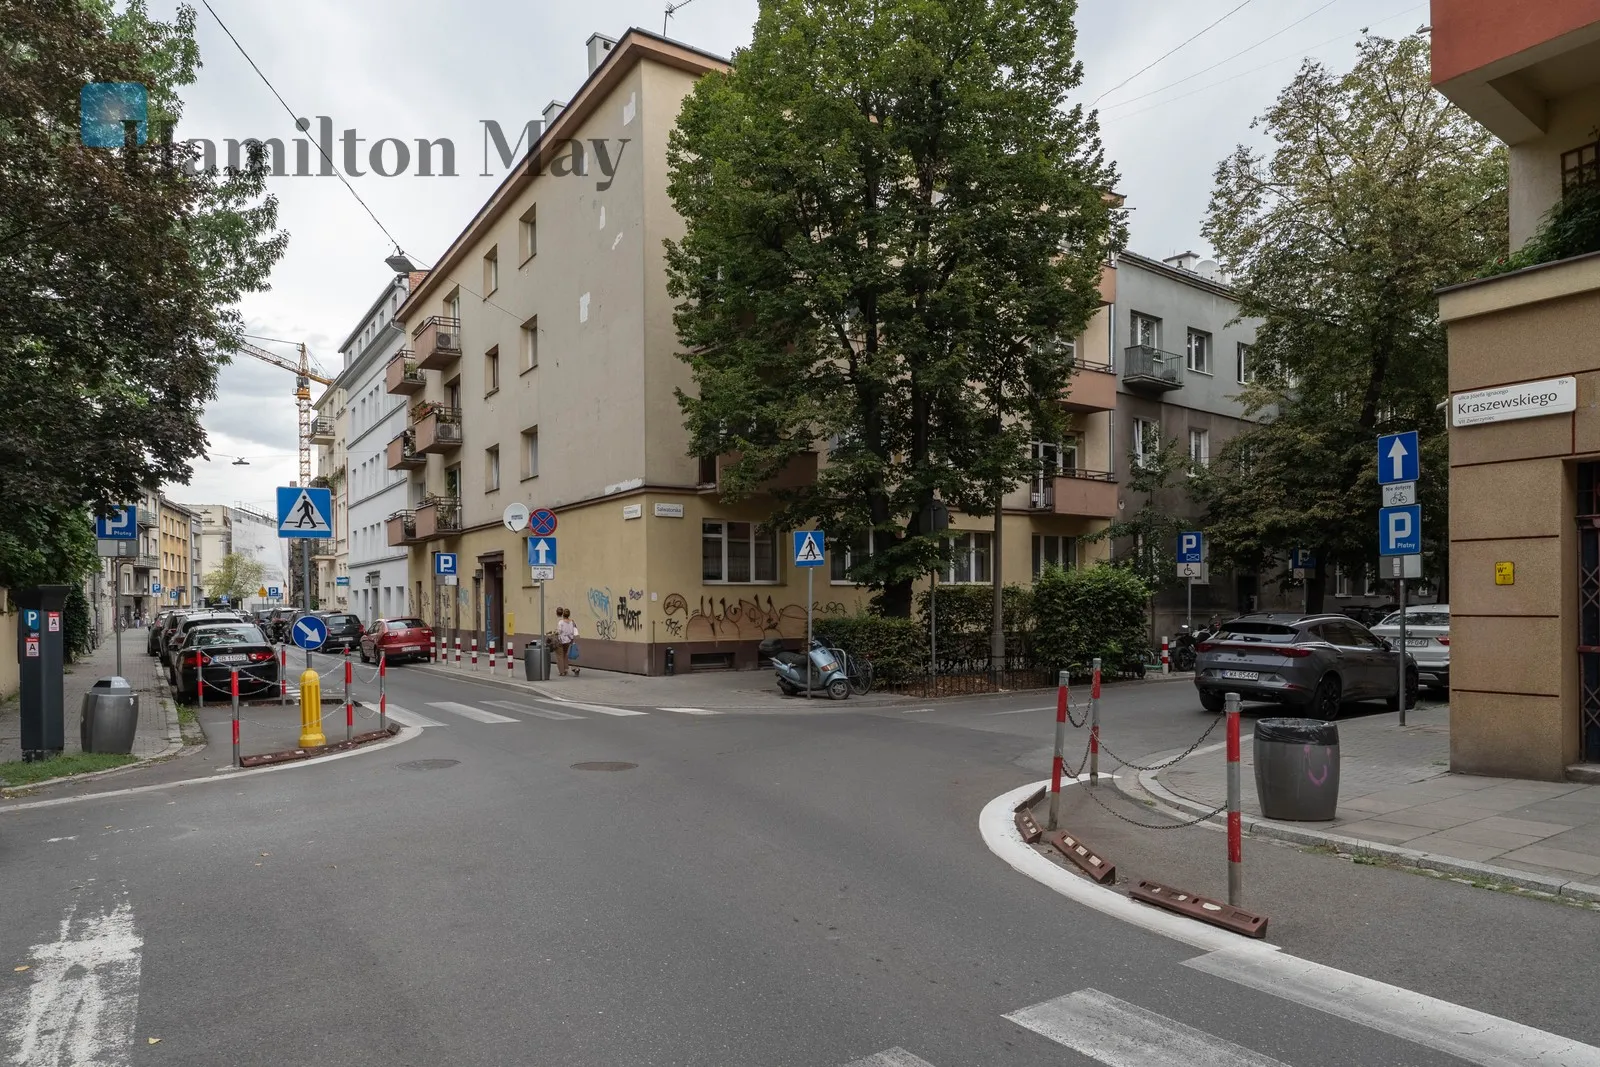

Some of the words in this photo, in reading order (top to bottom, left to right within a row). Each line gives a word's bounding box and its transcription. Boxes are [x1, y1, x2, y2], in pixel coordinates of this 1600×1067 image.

[1457, 391, 1558, 415] Kraszewskiego
[105, 508, 128, 535] P
[1388, 511, 1412, 549] P
[1182, 534, 1197, 554] P
[440, 555, 453, 572] P
[270, 588, 277, 596] P
[28, 611, 38, 626] P
[51, 618, 57, 626] A
[29, 643, 36, 651] A
